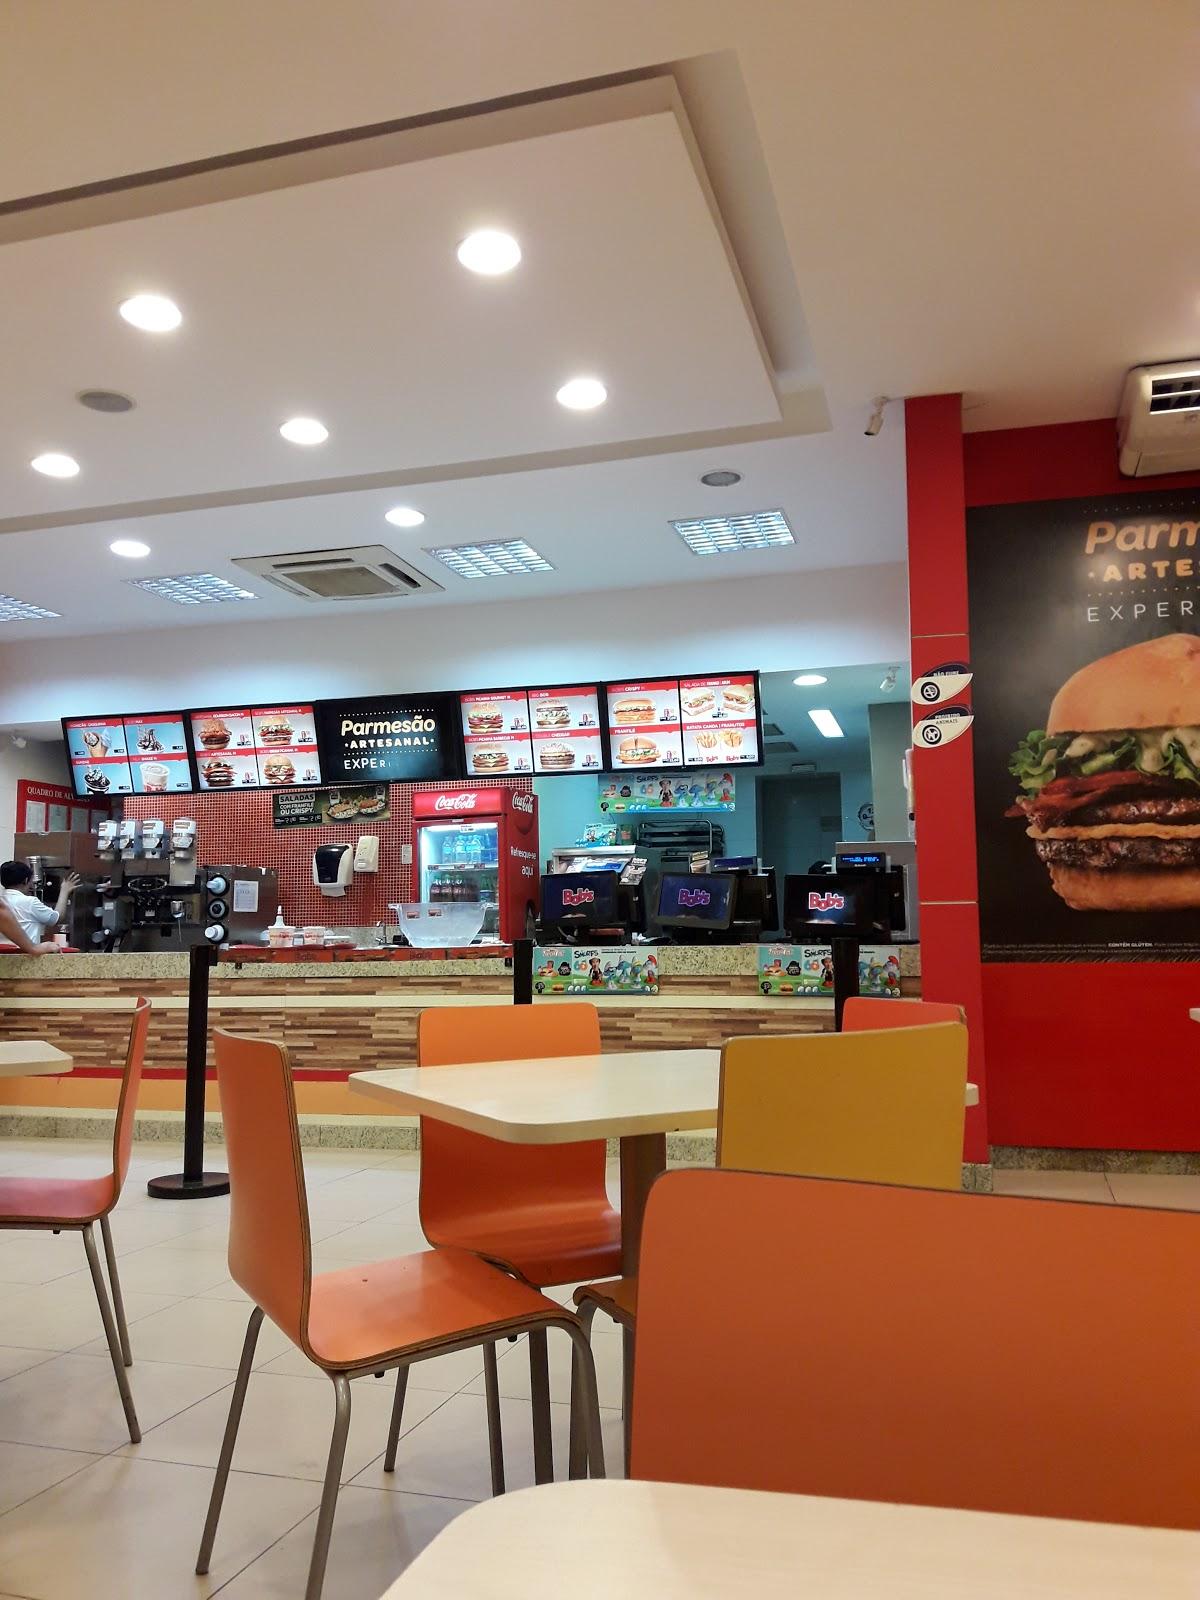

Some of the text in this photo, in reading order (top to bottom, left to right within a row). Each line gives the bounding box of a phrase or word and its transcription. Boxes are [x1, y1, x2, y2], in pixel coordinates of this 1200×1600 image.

[1103, 559, 1200, 582] ARTE
[1087, 600, 1194, 622] EXPER
[341, 714, 436, 736] Parmesão
[350, 736, 430, 749] ARTESANAL
[27, 786, 54, 797] QUADRO
[54, 790, 62, 798] DE
[280, 794, 314, 802] SALADAS
[522, 865, 534, 878] aqui
[562, 888, 595, 906] Bob's
[678, 888, 711, 907] Bob's
[808, 892, 844, 911] Bob's
